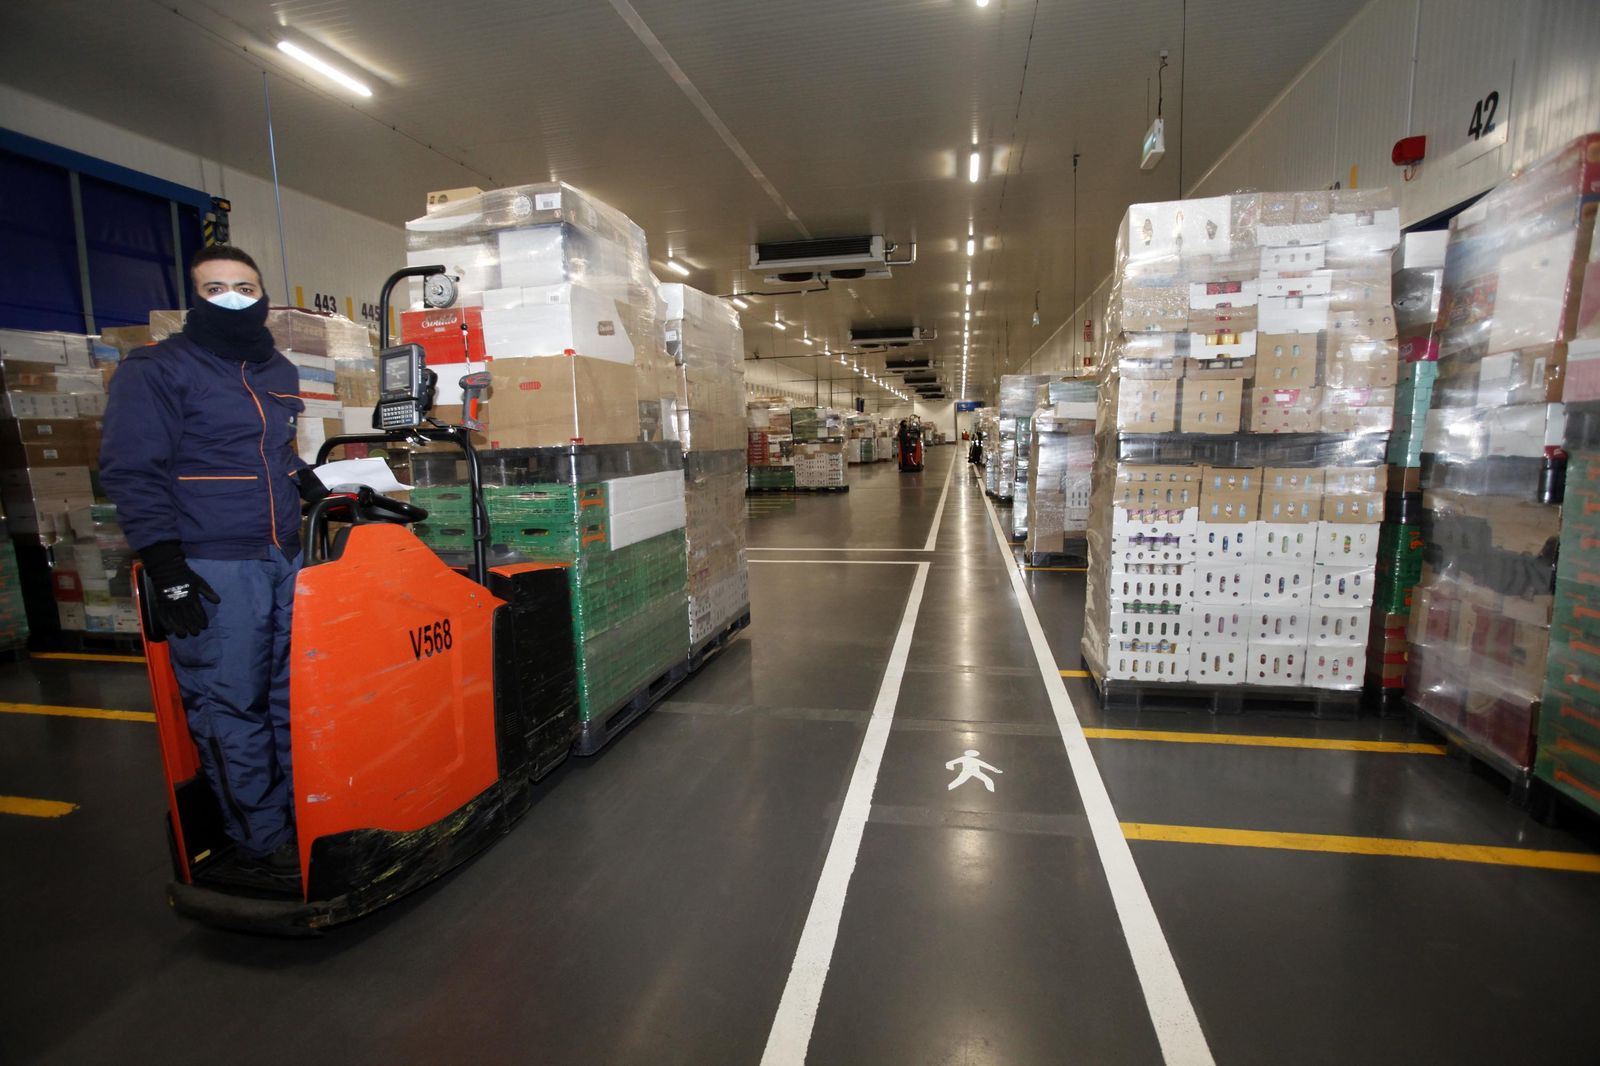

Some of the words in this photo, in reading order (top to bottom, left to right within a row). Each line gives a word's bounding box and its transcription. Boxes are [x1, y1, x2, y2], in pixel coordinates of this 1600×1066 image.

[1467, 91, 1499, 141] 42
[314, 293, 337, 313] 443
[361, 303, 381, 321] 445
[409, 619, 452, 661] V568
